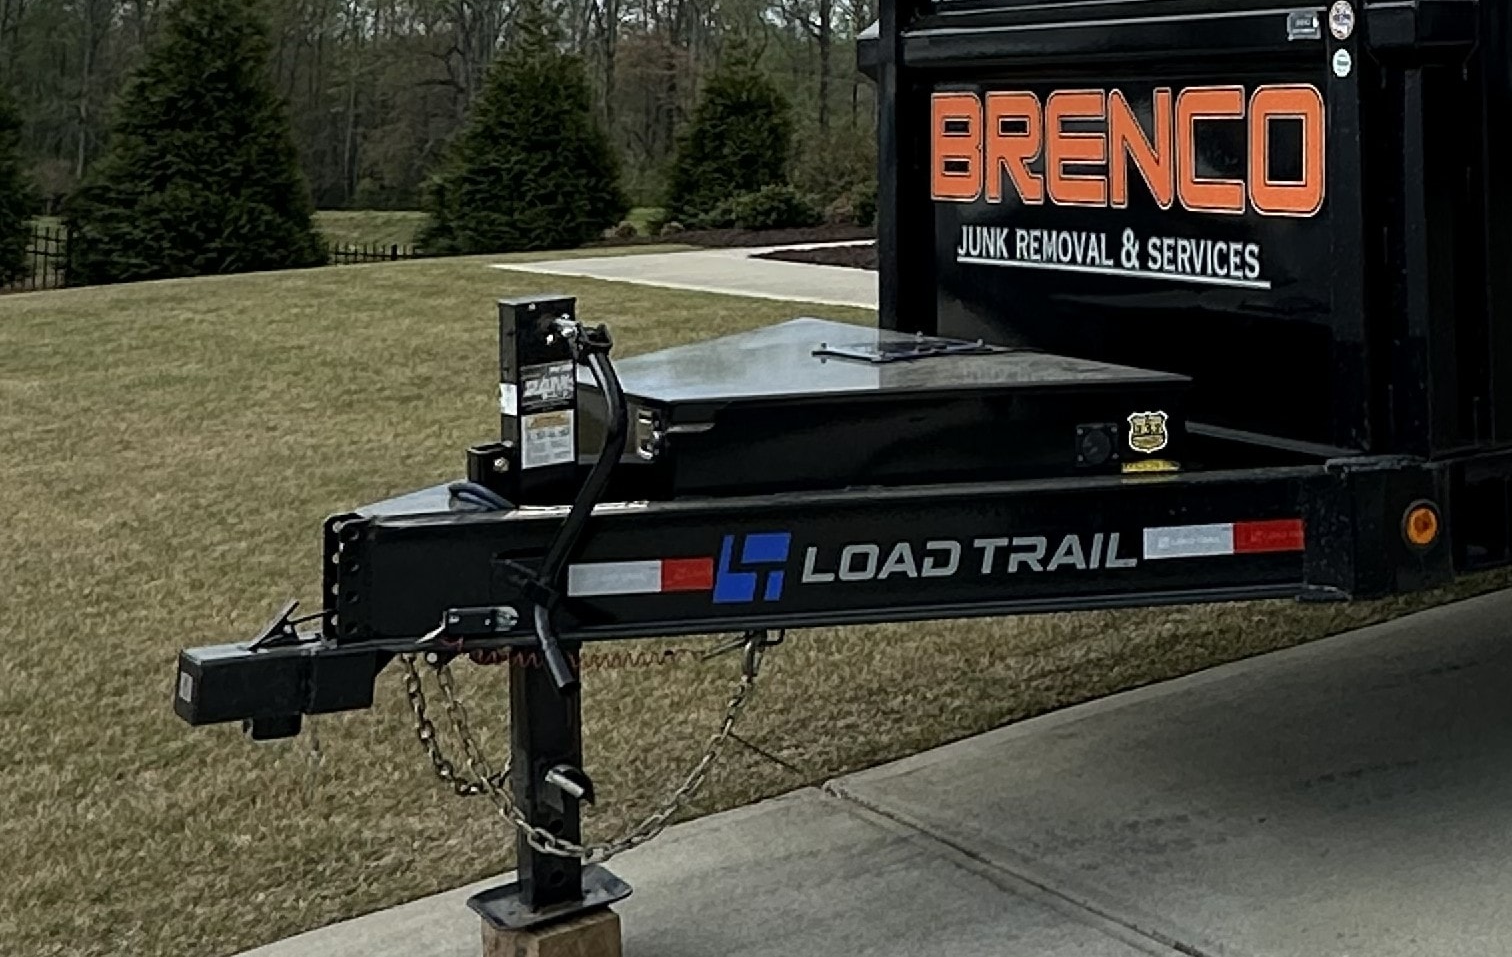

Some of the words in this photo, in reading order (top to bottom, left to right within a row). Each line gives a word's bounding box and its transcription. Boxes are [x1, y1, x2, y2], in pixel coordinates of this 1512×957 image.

[930, 83, 1326, 217] BRENCO
[958, 225, 1009, 258] JUNK
[1015, 228, 1114, 266] REMOVAL
[1120, 227, 1140, 269] &
[1147, 237, 1260, 279] SERVICES
[801, 541, 962, 584] LOAD
[973, 532, 1138, 574] TRAIL
